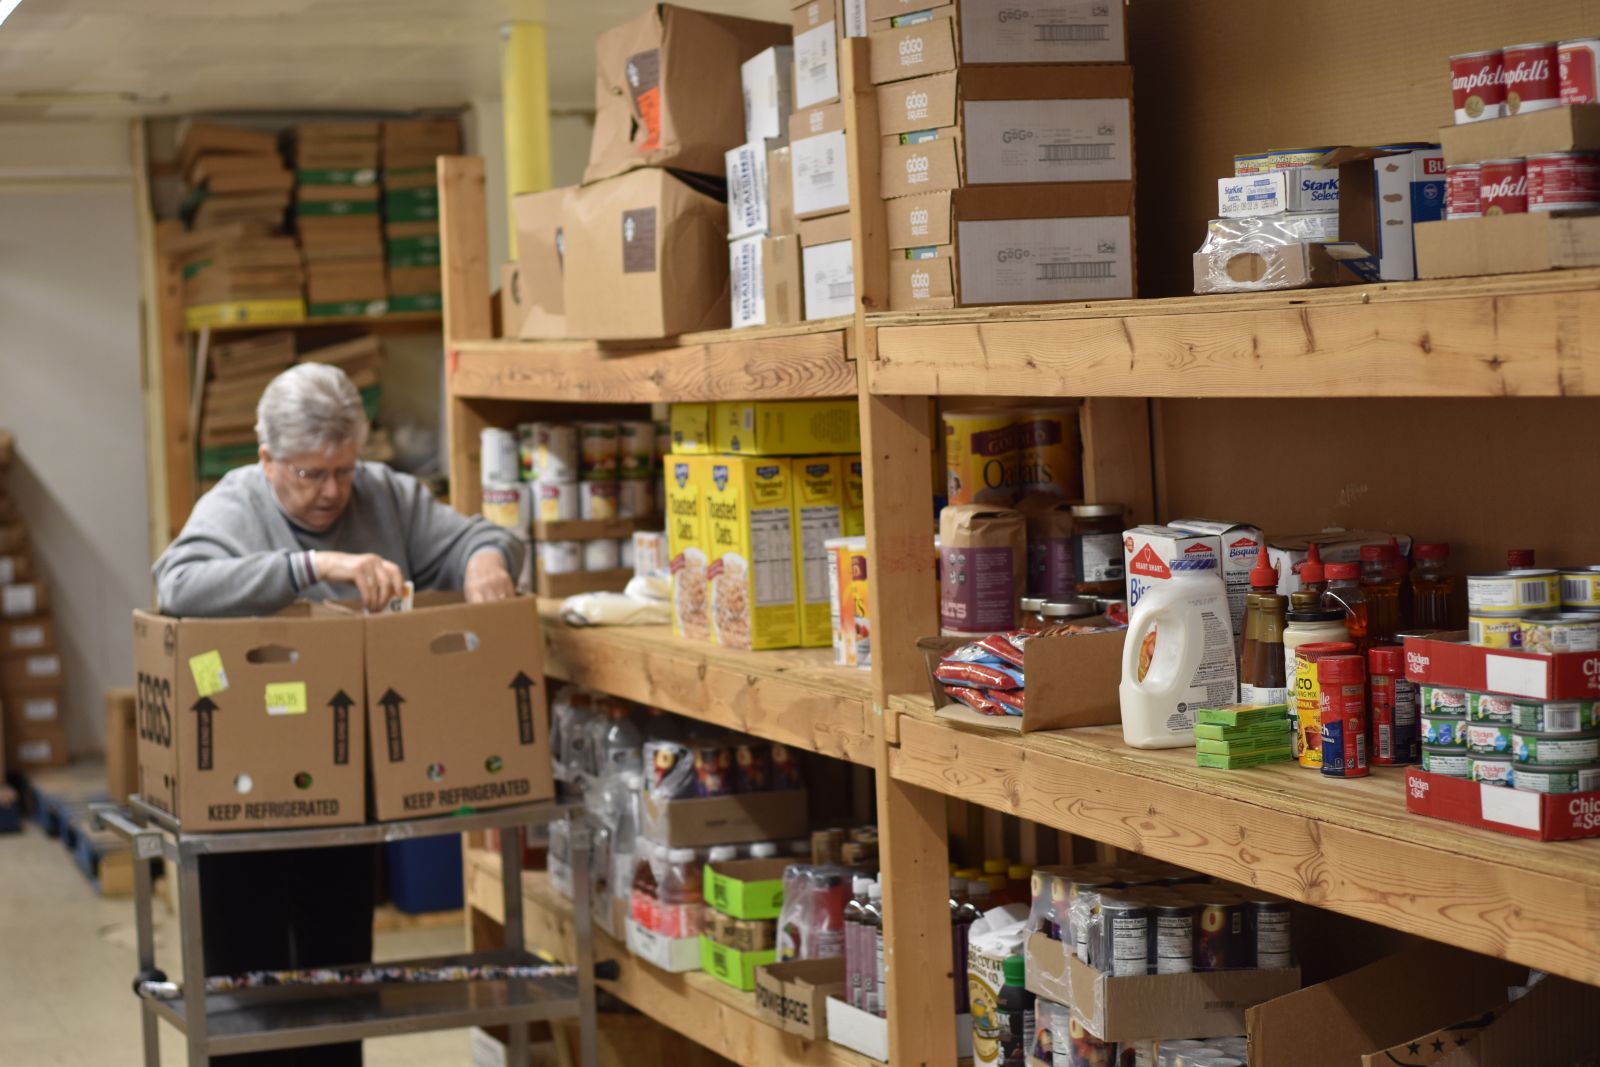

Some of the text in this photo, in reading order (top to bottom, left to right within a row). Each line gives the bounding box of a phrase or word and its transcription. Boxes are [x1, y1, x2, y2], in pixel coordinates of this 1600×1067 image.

[1451, 65, 1504, 93] ampbell
[1302, 179, 1339, 191] StarK
[1136, 562, 1163, 572] HEART SMART
[1407, 652, 1430, 665] Chicken
[138, 670, 171, 748] EGGS
[1482, 765, 1506, 773] Chicken
[1409, 776, 1429, 791] Chicken
[403, 779, 530, 810] KEEP REFRIGERATED
[207, 799, 339, 821] KEEP REFRIGERATED
[1569, 797, 1600, 815] Chic
[1583, 813, 1600, 830] Se
